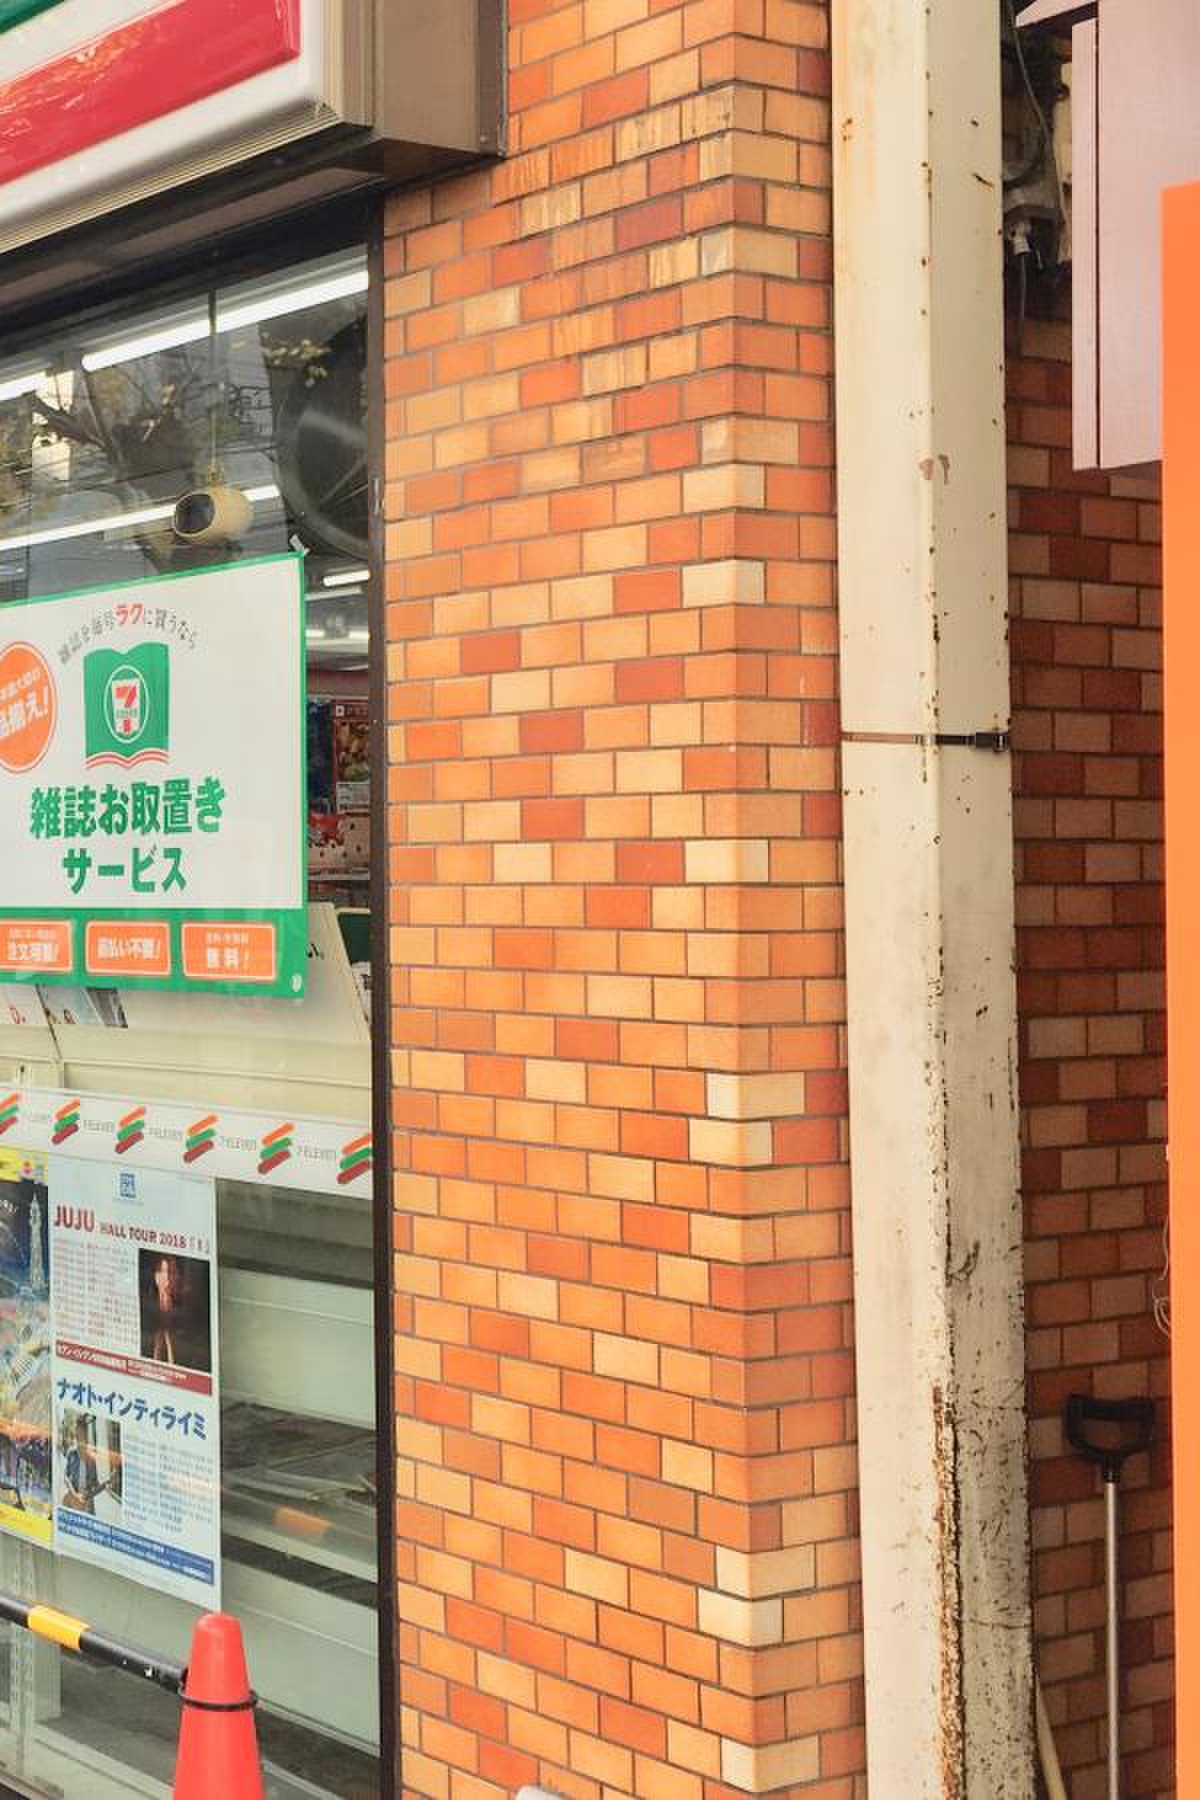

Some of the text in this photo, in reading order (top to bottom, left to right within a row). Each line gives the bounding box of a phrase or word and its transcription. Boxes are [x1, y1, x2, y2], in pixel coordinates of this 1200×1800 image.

[29, 776, 226, 838] 雑誌お取置き
[62, 844, 187, 894] サービス
[53, 1205, 95, 1233] JUJU
[100, 1222, 127, 1239] HALL
[128, 1226, 157, 1244] TOUR
[159, 1232, 187, 1249] 2018
